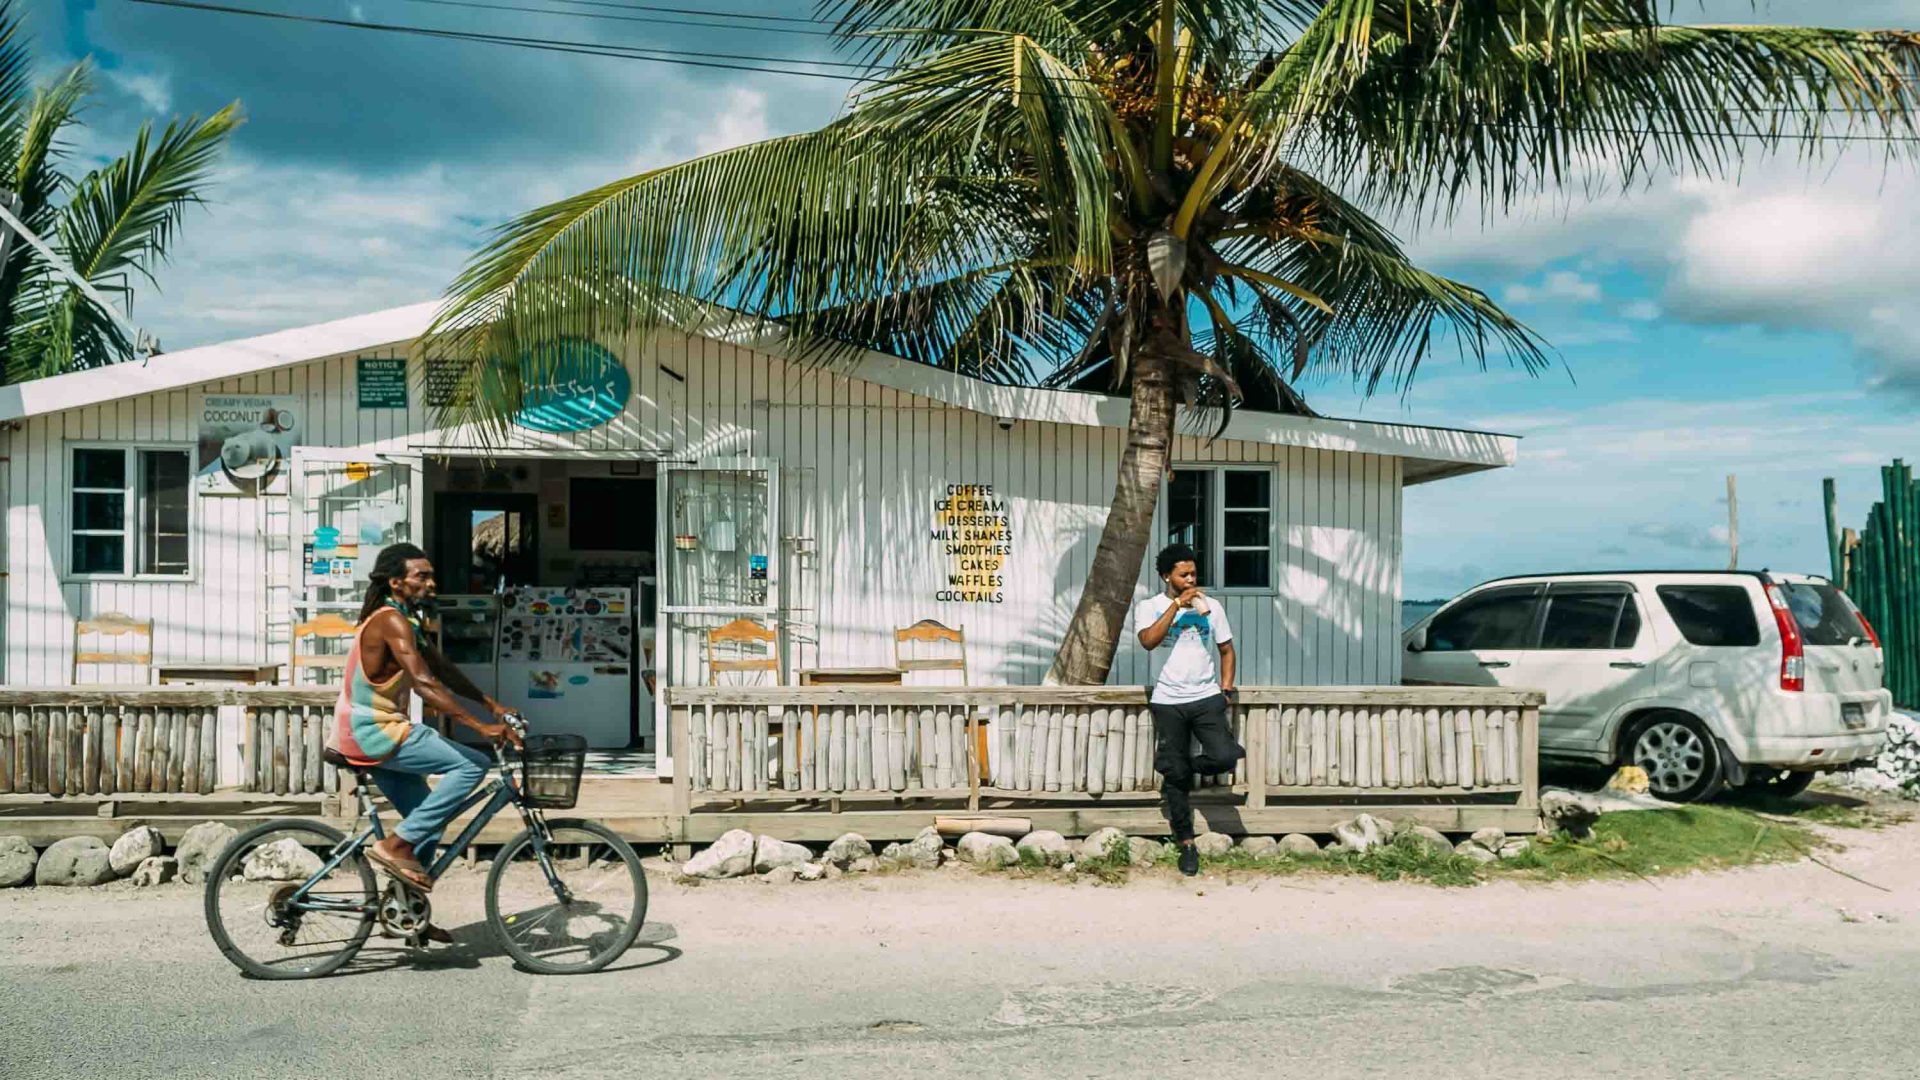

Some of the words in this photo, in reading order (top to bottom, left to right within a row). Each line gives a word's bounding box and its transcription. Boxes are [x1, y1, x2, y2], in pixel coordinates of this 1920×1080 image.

[364, 361, 399, 369] NOTICE
[203, 410, 261, 422] COCONUT
[946, 484, 993, 496] COFFEE
[934, 499, 953, 511] ICE
[956, 499, 1004, 511] CREAM
[948, 515, 1009, 527] DESSERTS
[931, 530, 959, 540] MILK
[964, 530, 1012, 541] SHAKES
[945, 544, 1011, 556] SMOOTHIES
[961, 559, 999, 571] CAKES
[948, 574, 1003, 587] WAFFLES
[935, 590, 1004, 603] COCKTAILS
